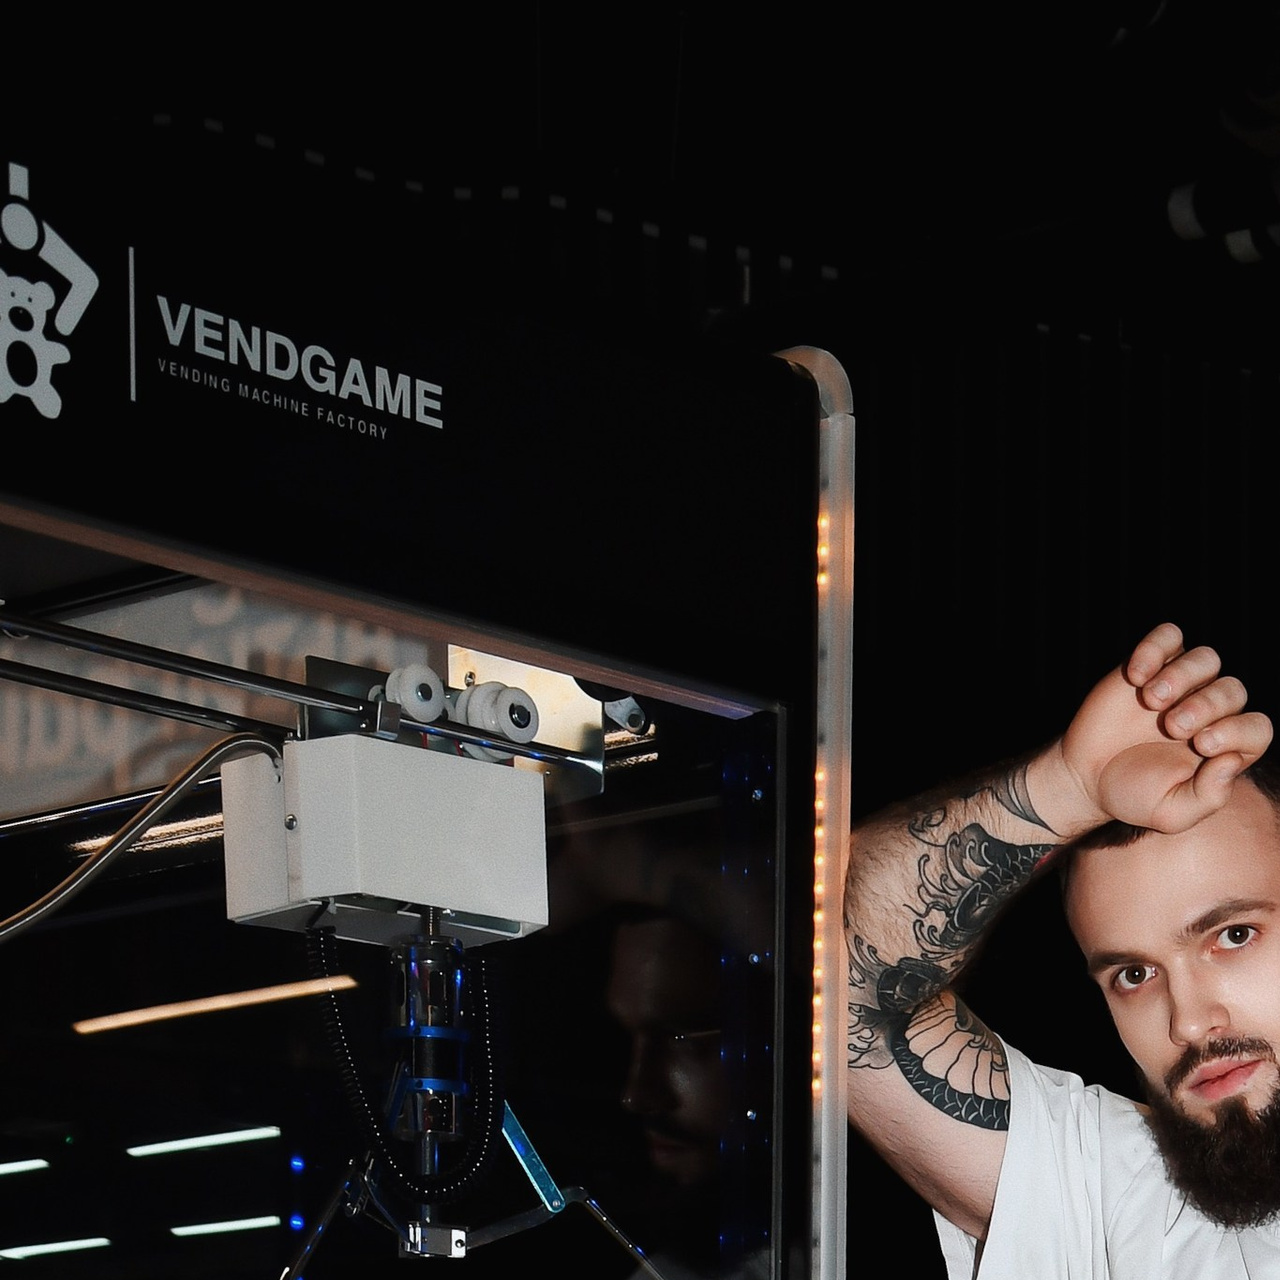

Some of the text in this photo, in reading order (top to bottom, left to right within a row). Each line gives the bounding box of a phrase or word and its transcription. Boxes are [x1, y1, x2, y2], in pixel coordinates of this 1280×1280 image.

[156, 294, 444, 430] VENDGAME
[157, 357, 388, 440] VENDING MACHINE FACTORY
